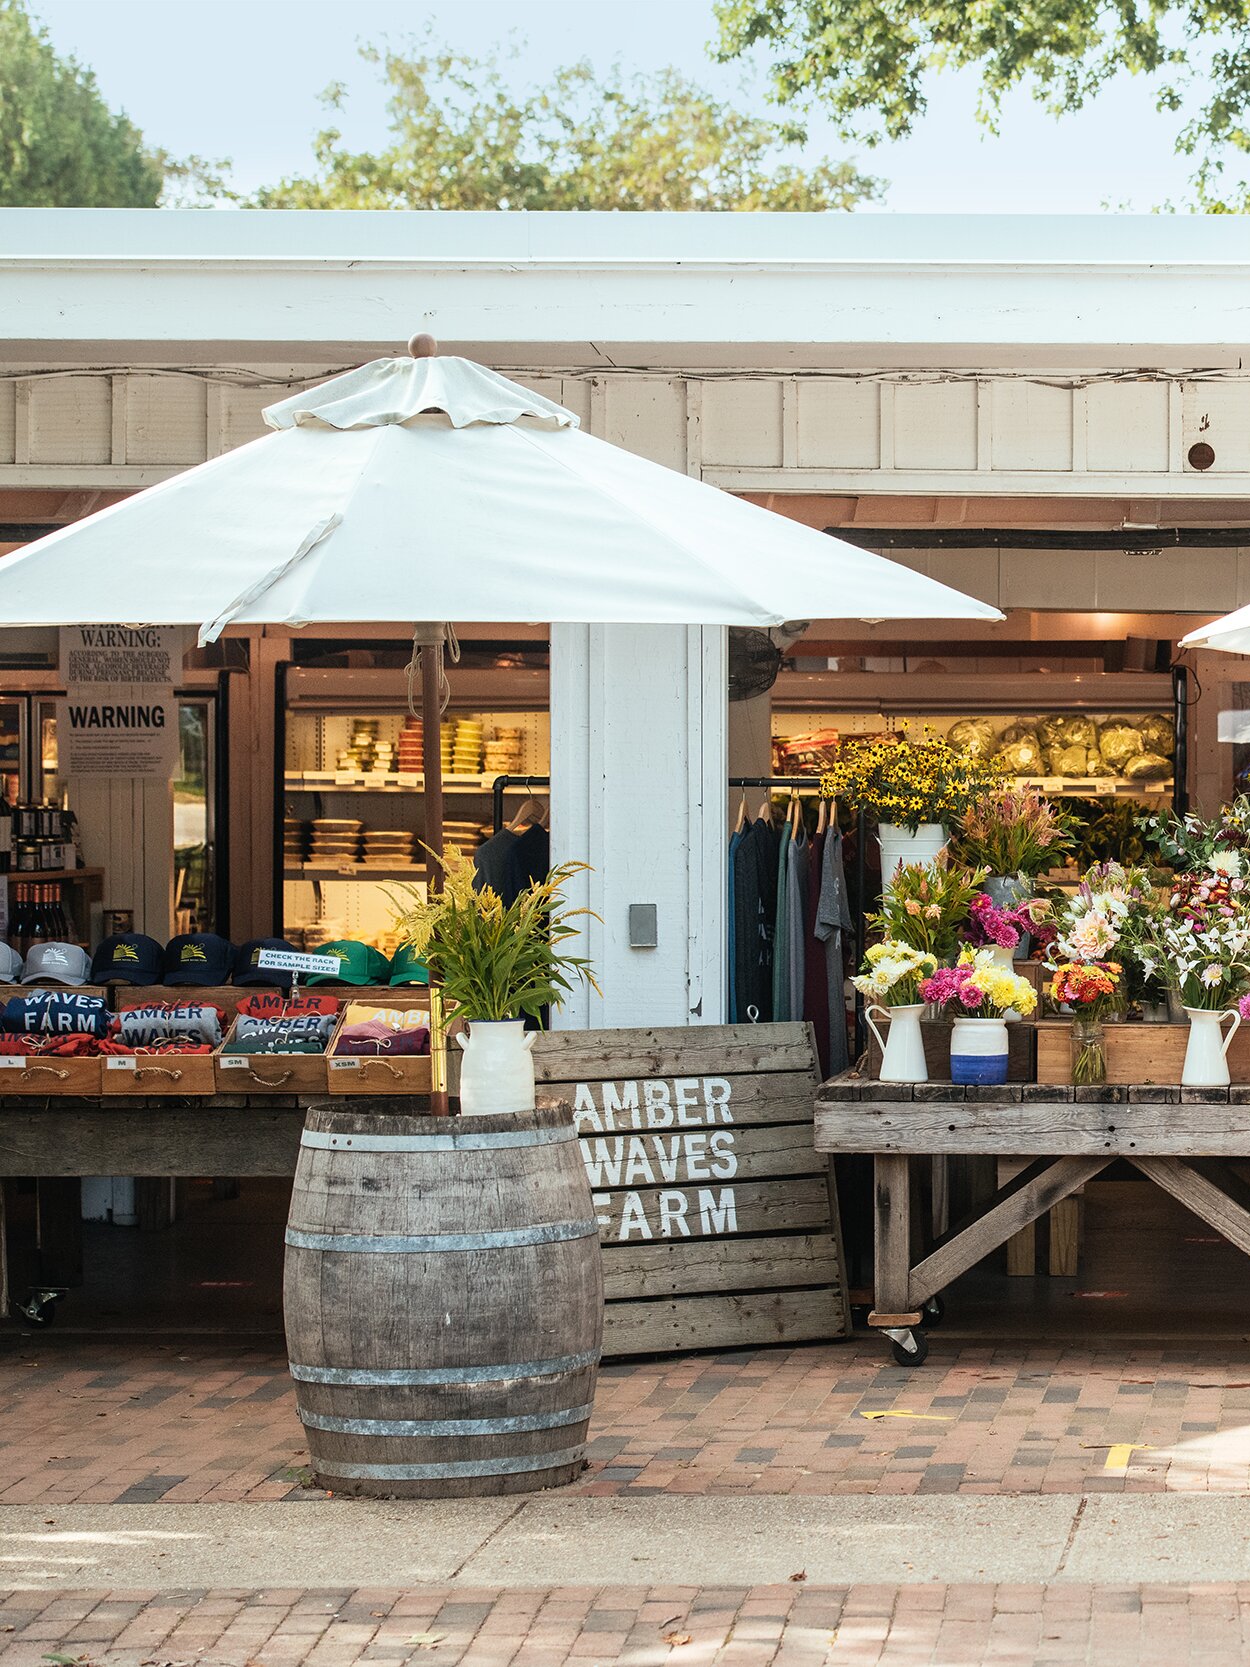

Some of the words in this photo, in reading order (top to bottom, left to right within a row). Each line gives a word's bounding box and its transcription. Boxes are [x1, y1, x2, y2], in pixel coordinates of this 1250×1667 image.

[81, 630, 160, 648] WARNING:
[68, 705, 165, 728] WARNING
[277, 961, 311, 970] SAMPLE
[312, 957, 335, 965] RACK
[24, 990, 105, 1009] WAVES
[24, 1012, 96, 1032] FARM
[572, 1077, 734, 1132] AMBER
[579, 1131, 738, 1187] WAVES
